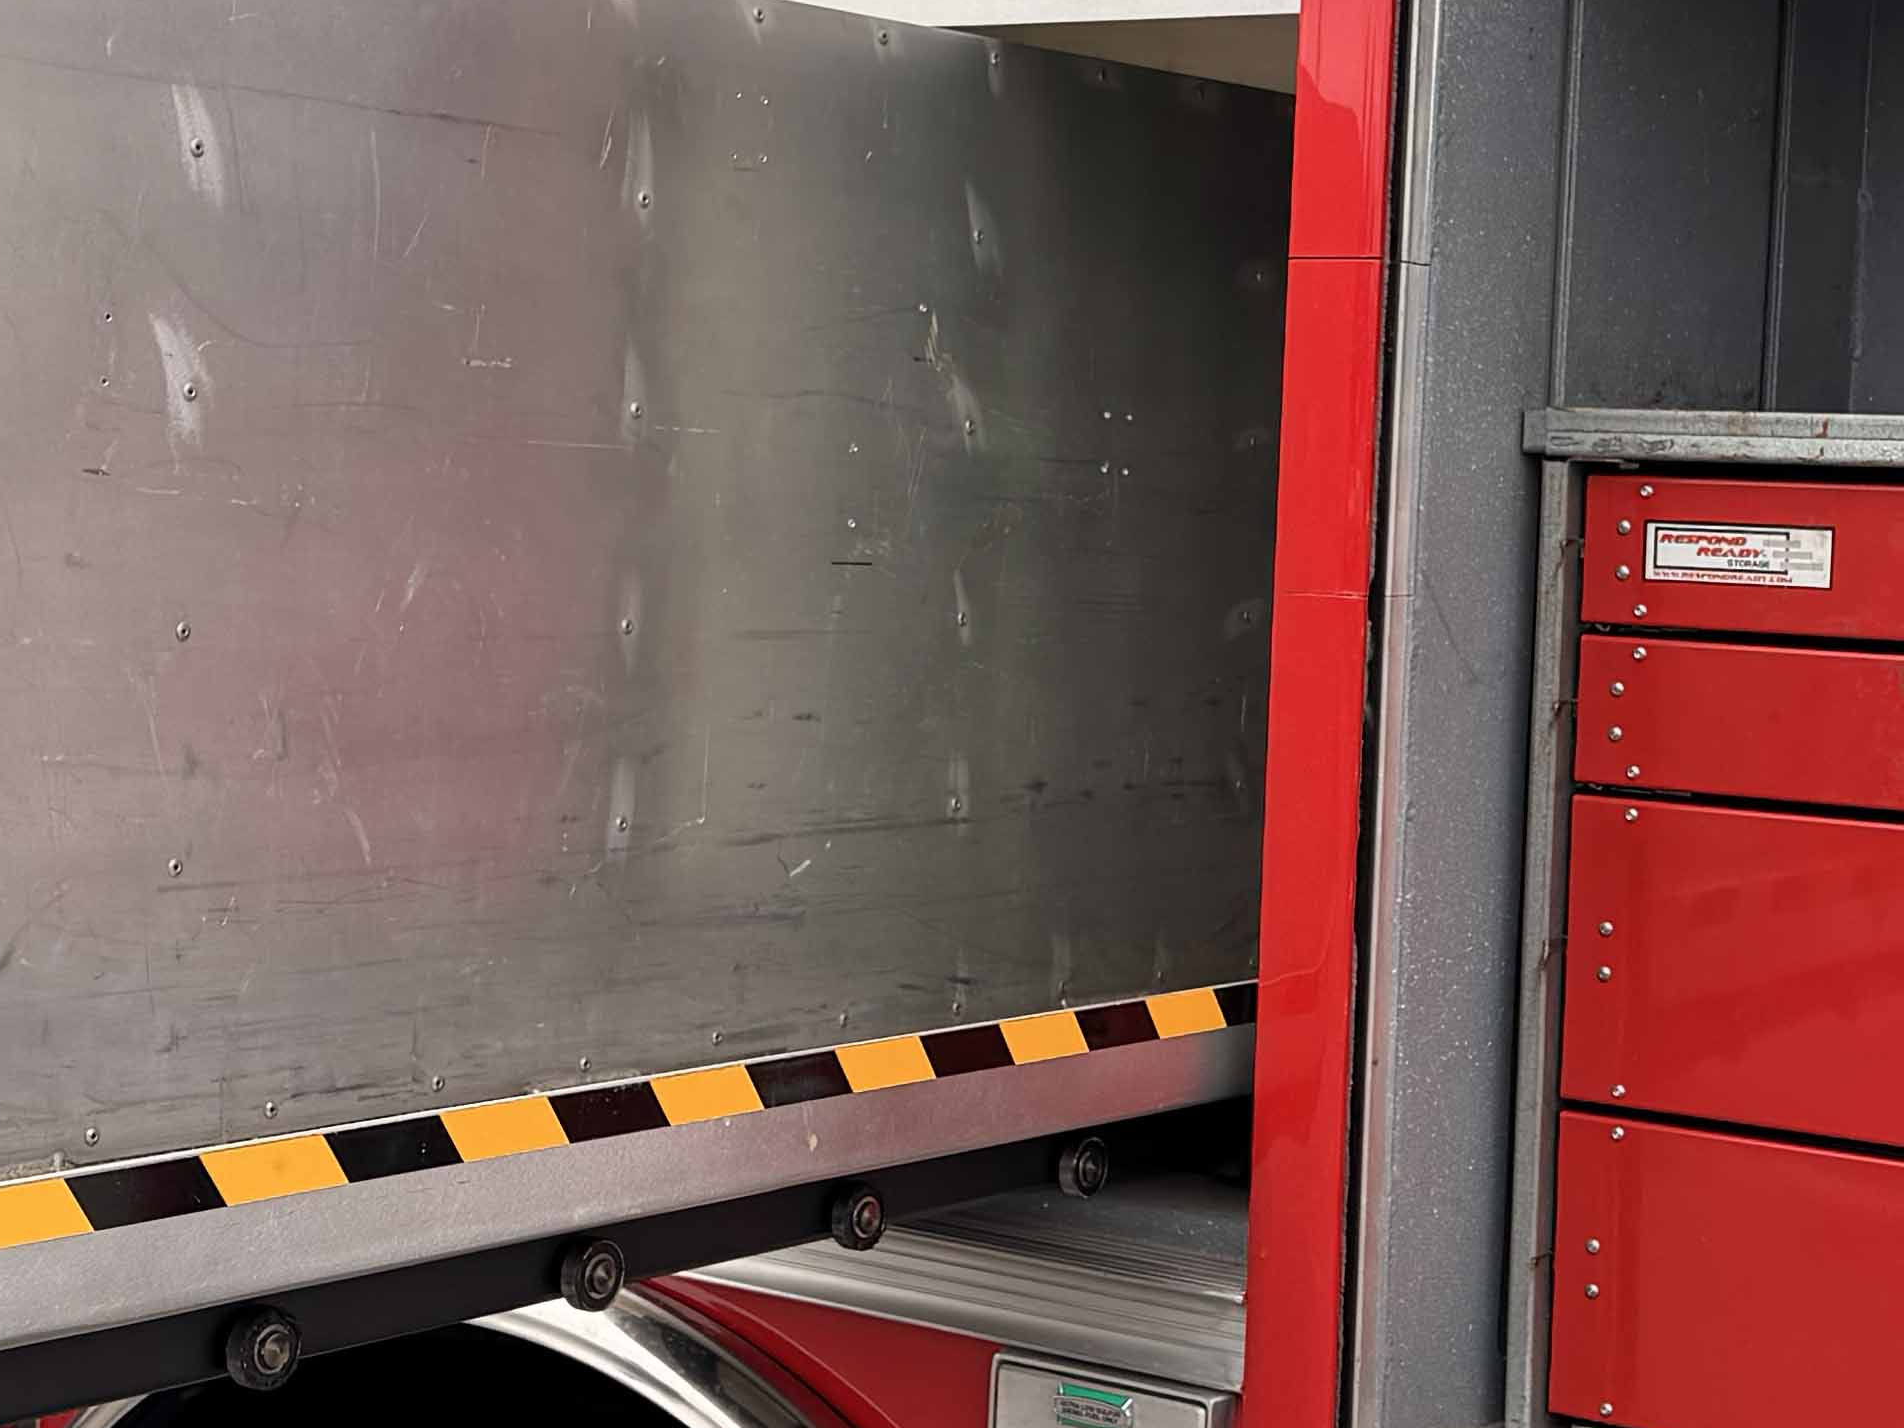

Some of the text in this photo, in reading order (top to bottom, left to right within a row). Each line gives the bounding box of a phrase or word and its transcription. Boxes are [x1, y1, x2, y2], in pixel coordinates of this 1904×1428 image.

[1659, 532, 1747, 546] RESPOND
[1696, 547, 1763, 558] READY
[1727, 559, 1770, 569] STORAGE
